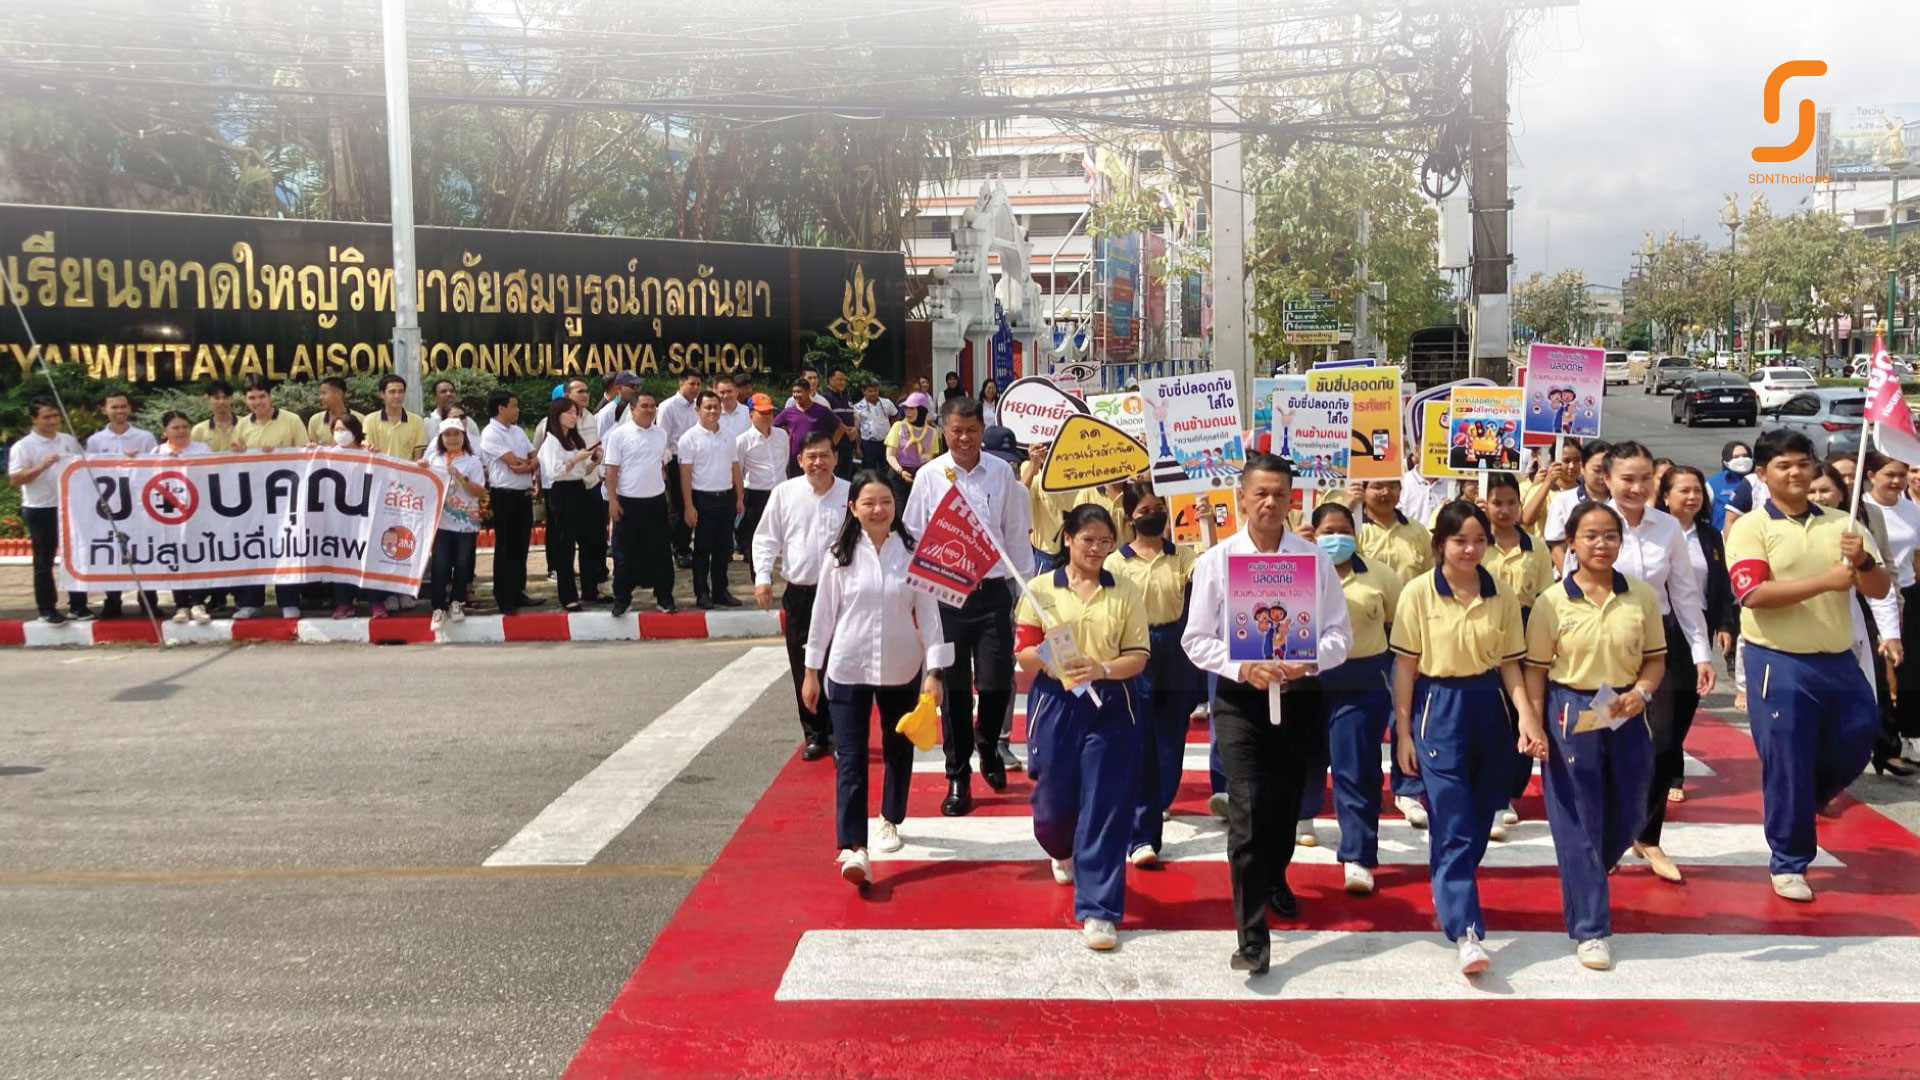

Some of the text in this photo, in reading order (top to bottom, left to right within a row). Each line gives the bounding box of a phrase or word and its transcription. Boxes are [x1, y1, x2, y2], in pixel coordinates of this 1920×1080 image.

[668, 342, 773, 375] SCHOOL
[1158, 377, 1232, 398] ขับขี่ปลอดภัย
[1316, 374, 1395, 393] ขับขี่ปลอดภัย
[1207, 393, 1235, 410] ใส่ใจ
[1288, 393, 1350, 410] ขับขี่ปลอดภัย
[1173, 414, 1237, 432] คนข้ามถนน
[1327, 411, 1349, 425] ใส่ใจ
[1079, 428, 1101, 441] ลด
[1295, 425, 1348, 440] คนข้ามถนน
[1055, 441, 1136, 462] ความเร็วสักนิด
[1063, 459, 1137, 482] ชีวิตปลอดภัย
[90, 525, 367, 572] ที่ไม่สูบไม่ดื่มไม่เสพ
